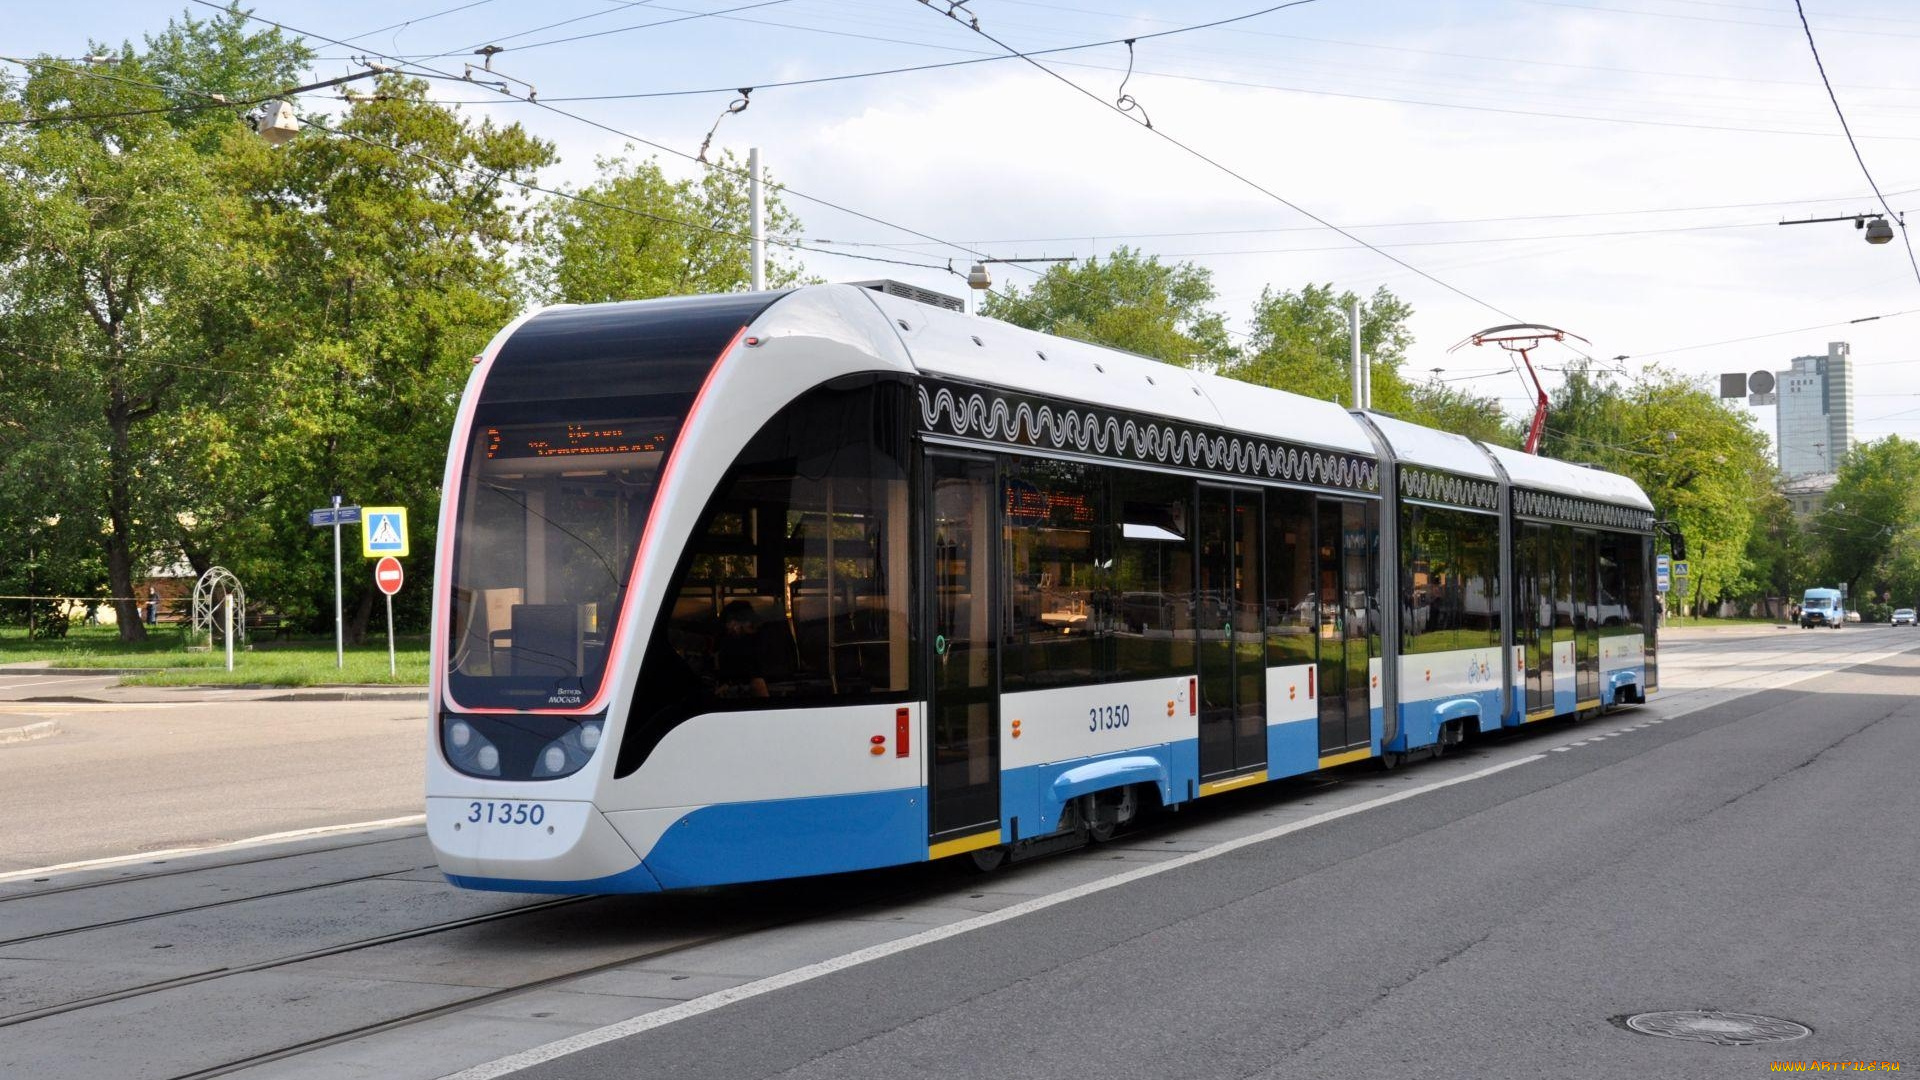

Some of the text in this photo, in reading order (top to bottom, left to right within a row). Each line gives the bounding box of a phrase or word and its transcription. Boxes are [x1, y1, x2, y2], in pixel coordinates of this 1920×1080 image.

[549, 696, 581, 704] МОСКВА
[1089, 704, 1130, 733] 31350
[468, 802, 544, 825] 31350
